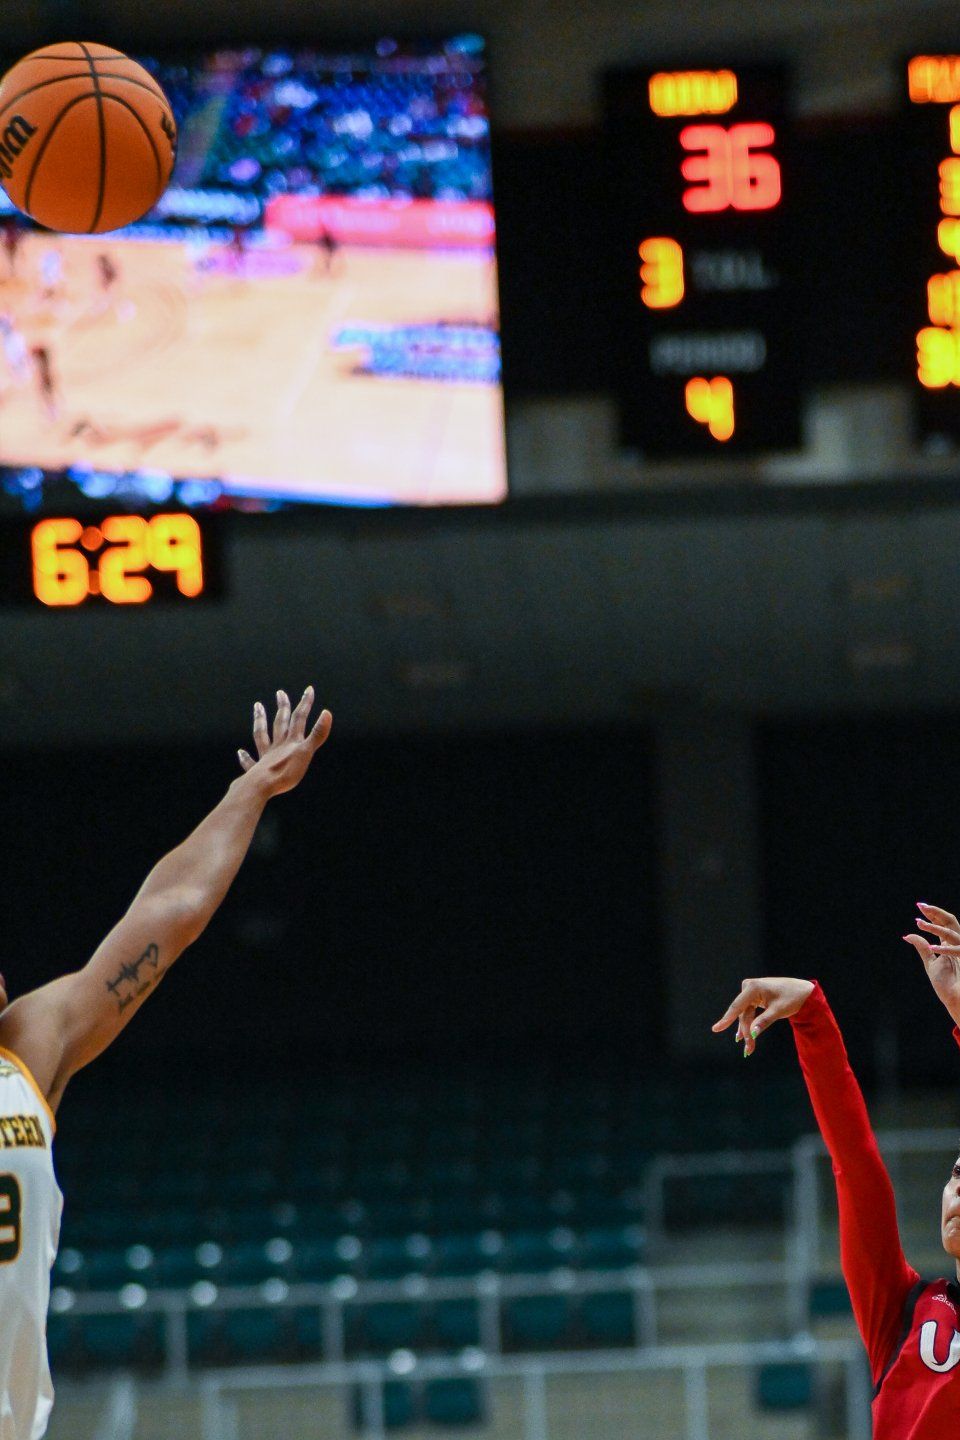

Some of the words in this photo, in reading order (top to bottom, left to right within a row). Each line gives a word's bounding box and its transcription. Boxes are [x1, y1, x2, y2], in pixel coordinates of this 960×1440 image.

[679, 122, 781, 212] 36
[639, 237, 684, 309] 3
[32, 512, 204, 606] 6:29
